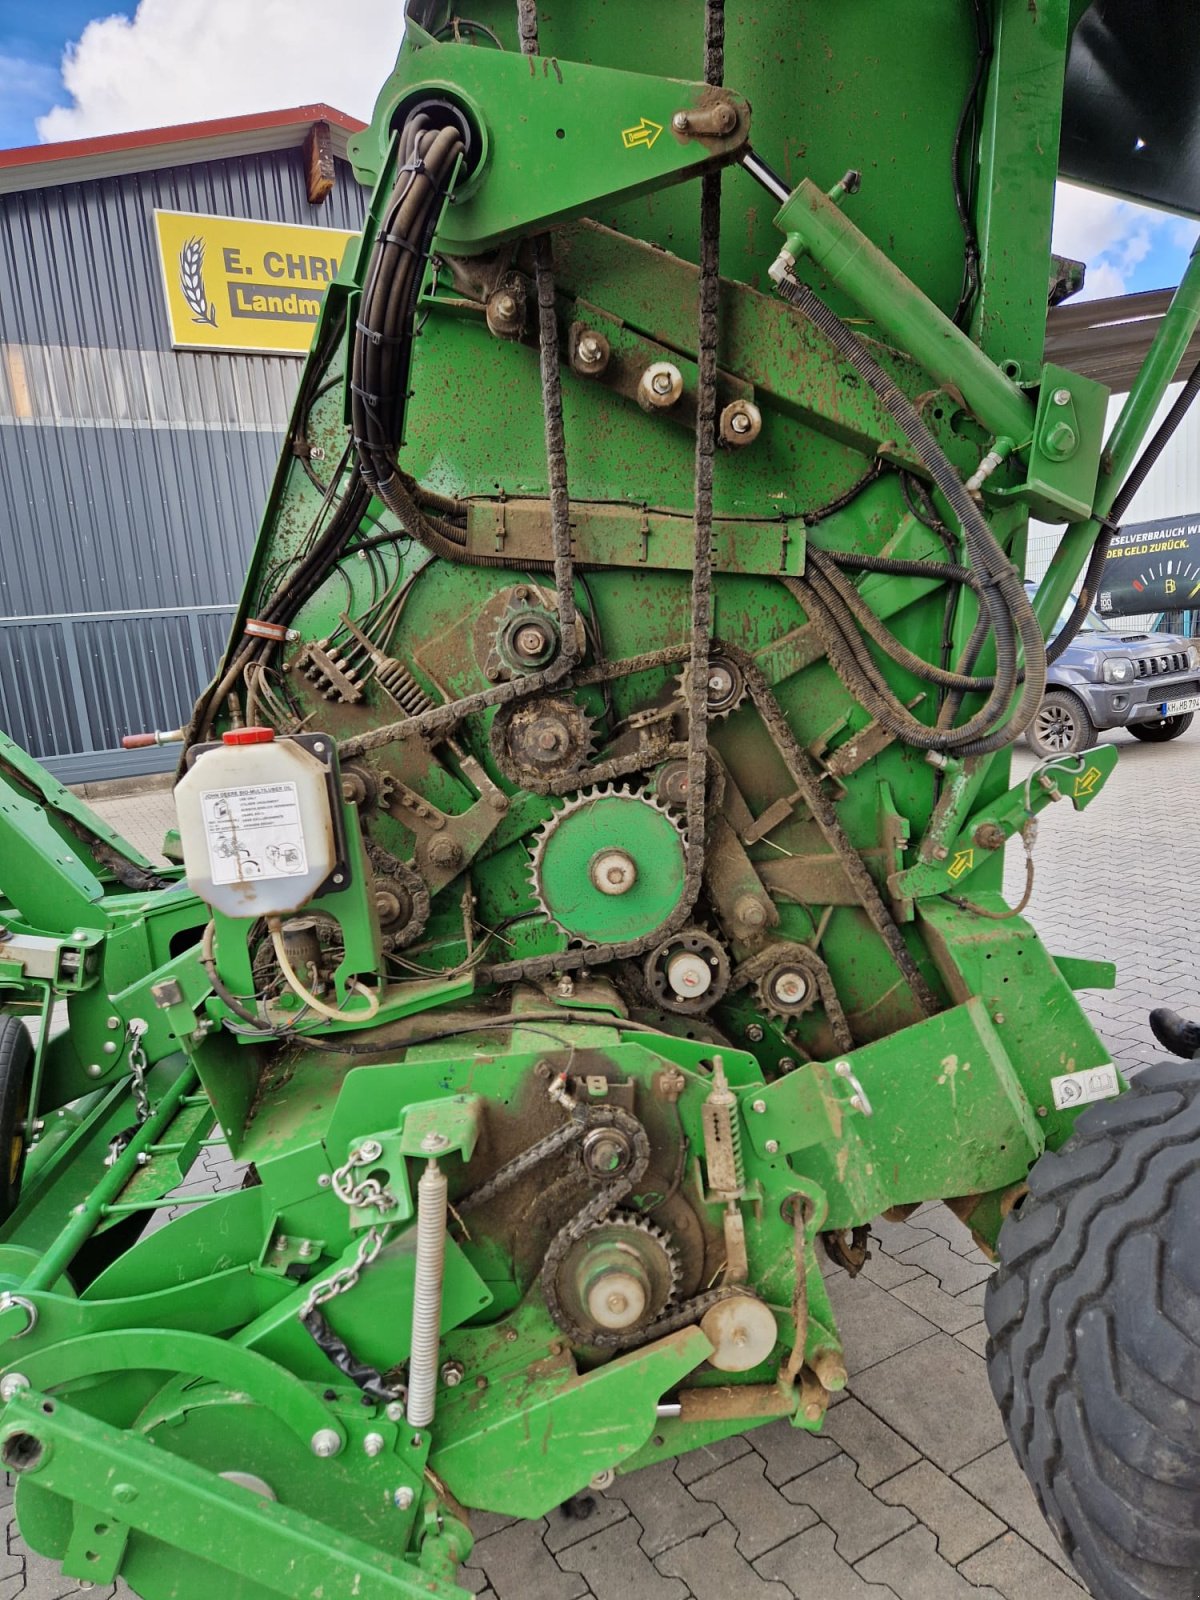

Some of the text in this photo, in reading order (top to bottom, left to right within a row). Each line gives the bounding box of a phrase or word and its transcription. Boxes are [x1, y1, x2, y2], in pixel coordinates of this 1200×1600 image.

[223, 247, 339, 282] E. CHRI
[236, 289, 320, 315] Landm
[1110, 526, 1185, 546] ESELVERBRAUCH
[1106, 539, 1190, 559] DER GELD ZURÜCK.
